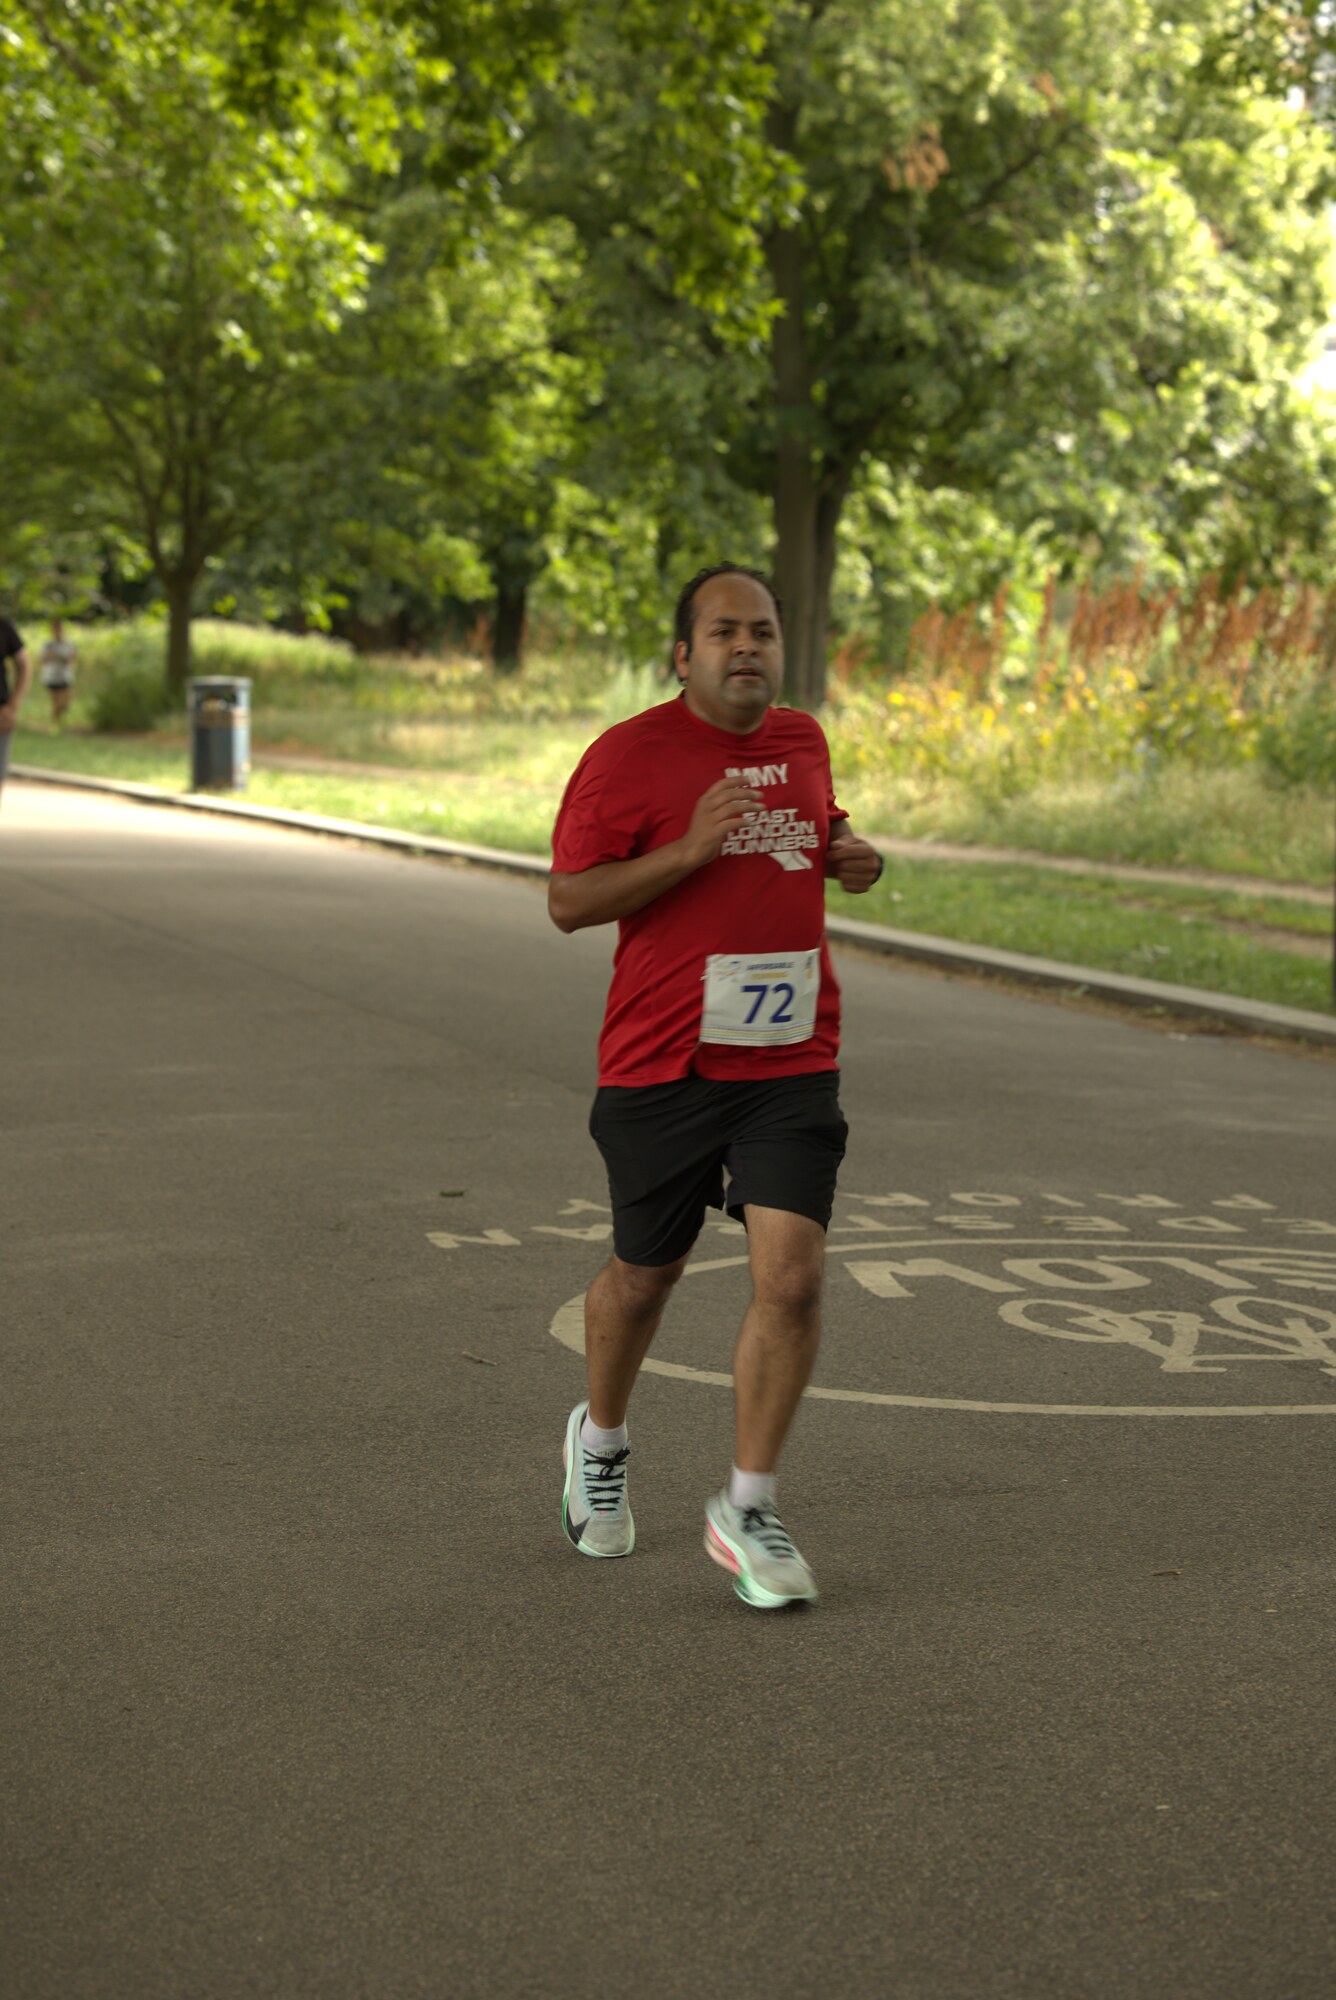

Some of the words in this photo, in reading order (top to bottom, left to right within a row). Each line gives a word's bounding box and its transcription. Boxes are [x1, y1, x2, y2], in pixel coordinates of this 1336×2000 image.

[742, 808, 799, 826] EAST
[727, 820, 816, 842] LONDON
[720, 834, 820, 857] RUNNERS
[741, 982, 795, 1025] 72
[557, 1192, 1278, 1216] PRIORY
[842, 1255, 1336, 1298] SLOW
